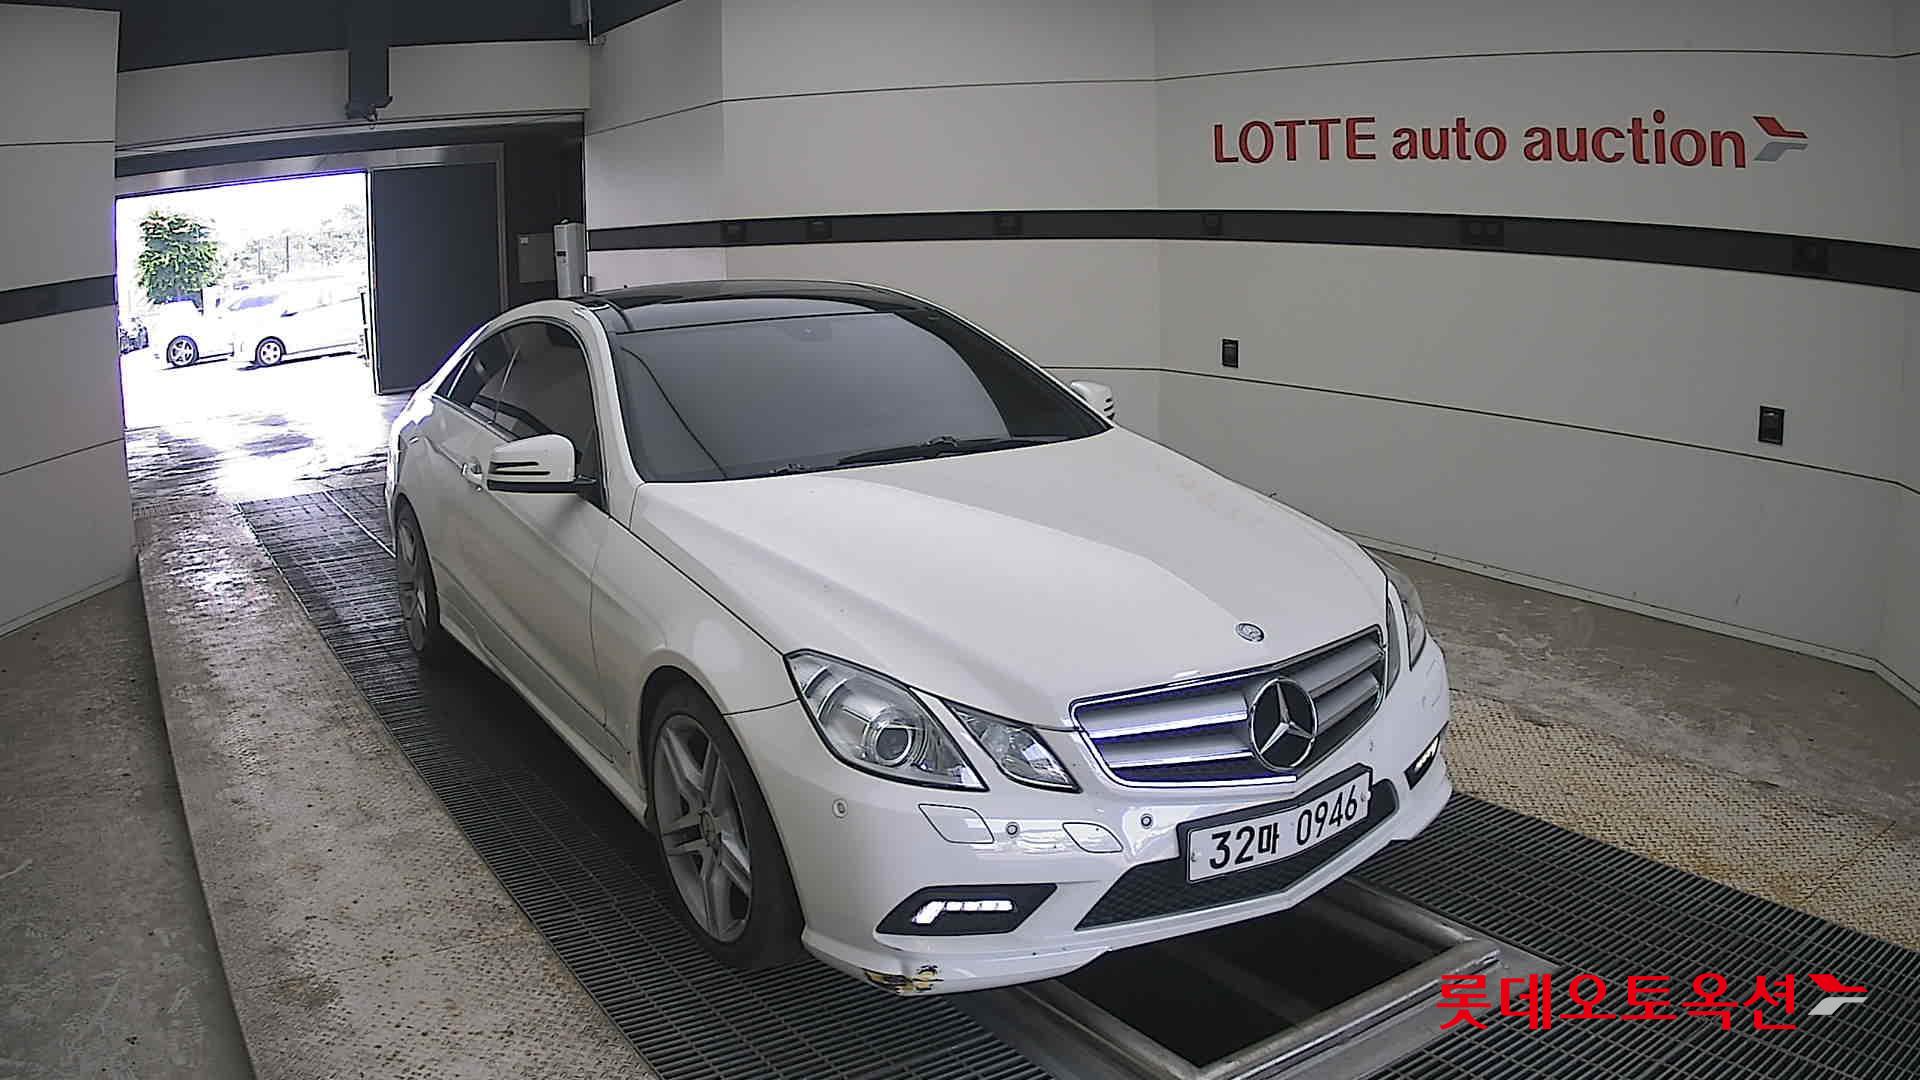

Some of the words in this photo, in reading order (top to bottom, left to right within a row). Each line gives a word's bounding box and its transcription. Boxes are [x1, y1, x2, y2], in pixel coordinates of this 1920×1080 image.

[1213, 116, 1376, 163] LOTTE
[1391, 117, 1507, 161] auto
[1523, 109, 1746, 168] auction
[1209, 822, 1279, 869] 32마
[1296, 785, 1358, 846] 0946
